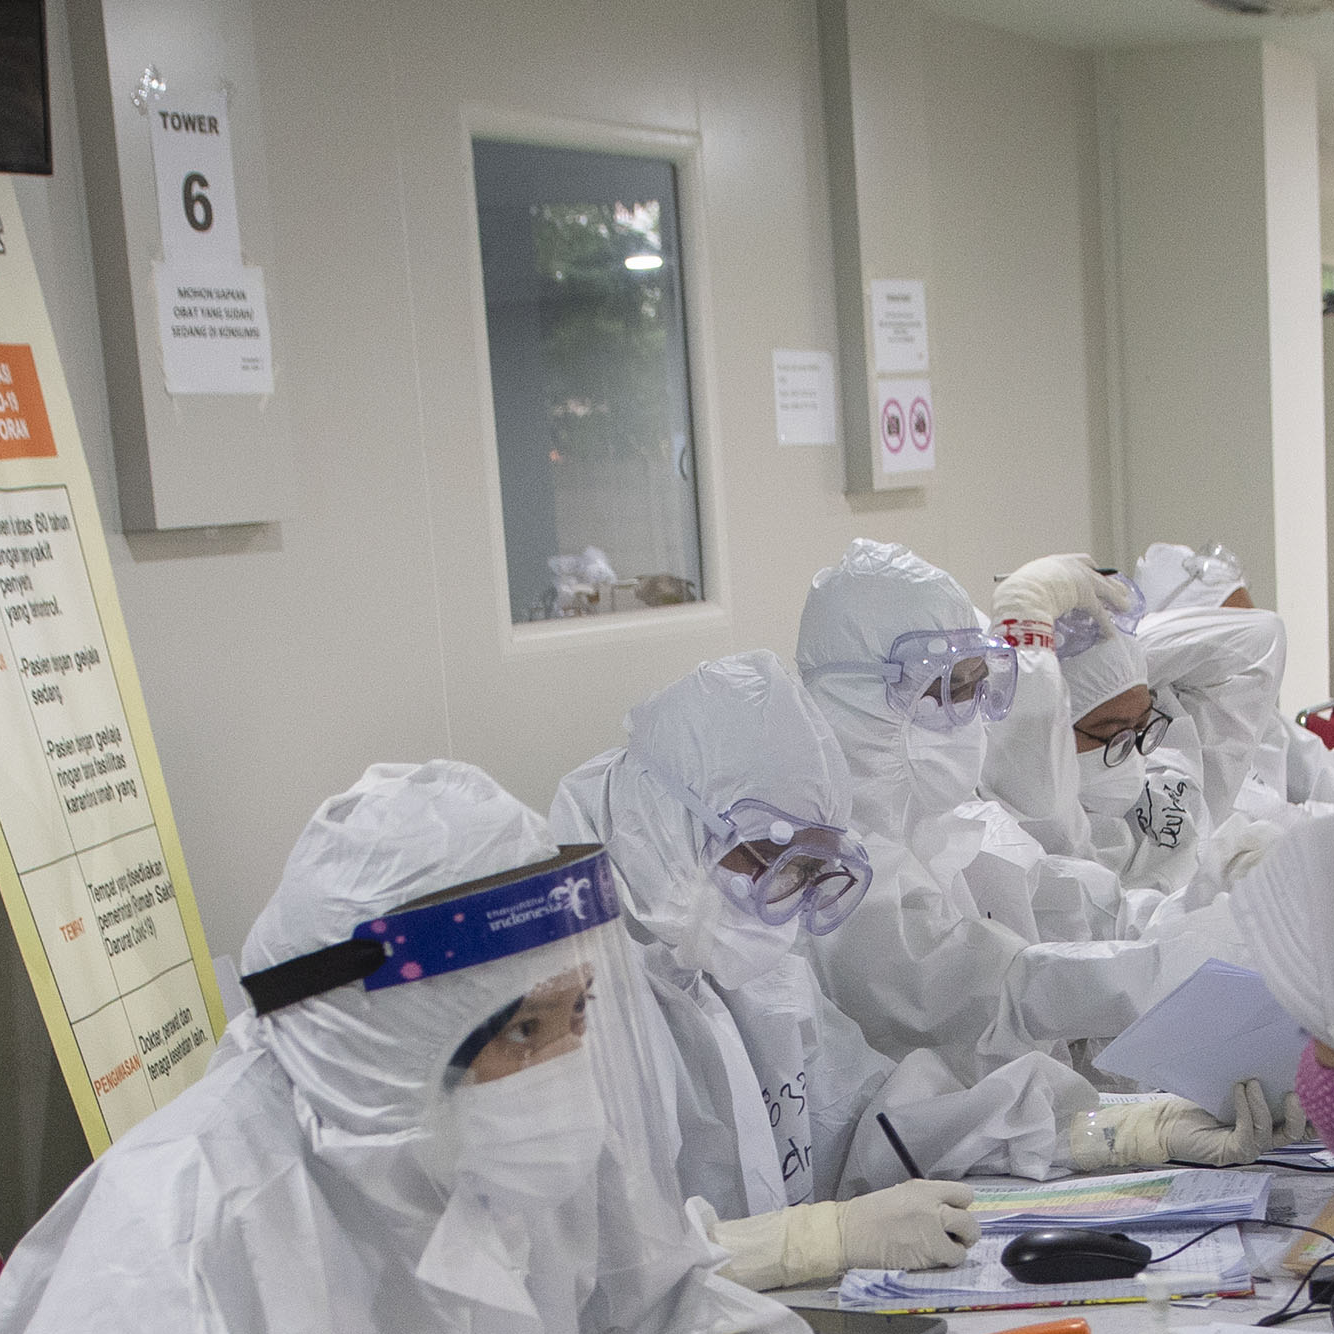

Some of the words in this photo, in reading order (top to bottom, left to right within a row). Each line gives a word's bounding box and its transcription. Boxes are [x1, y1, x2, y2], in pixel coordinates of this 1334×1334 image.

[158, 111, 219, 135] TOWER
[183, 171, 214, 232] 6
[34, 512, 49, 533] 60
[4, 603, 31, 628] yang
[115, 778, 138, 803] yang
